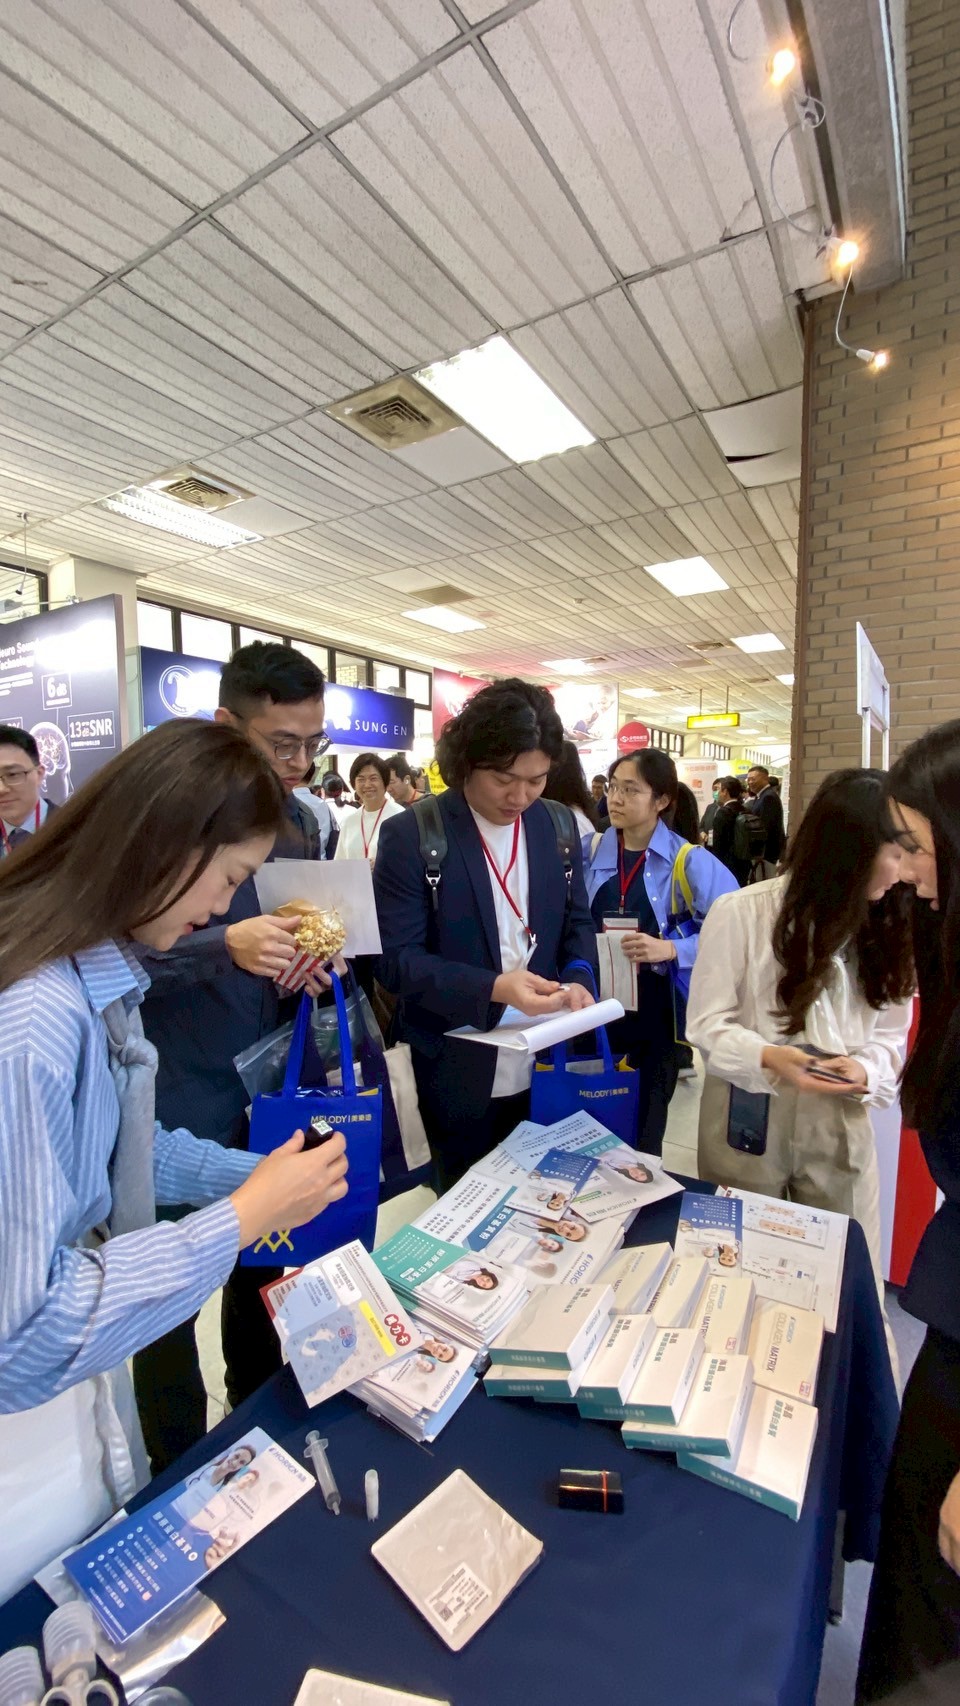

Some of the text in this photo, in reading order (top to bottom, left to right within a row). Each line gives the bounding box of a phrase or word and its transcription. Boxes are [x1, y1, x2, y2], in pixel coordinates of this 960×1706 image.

[354, 719, 407, 736] SUNG EN
[579, 1090, 610, 1099] MELODY
[766, 1345, 781, 1374] MATRIX
